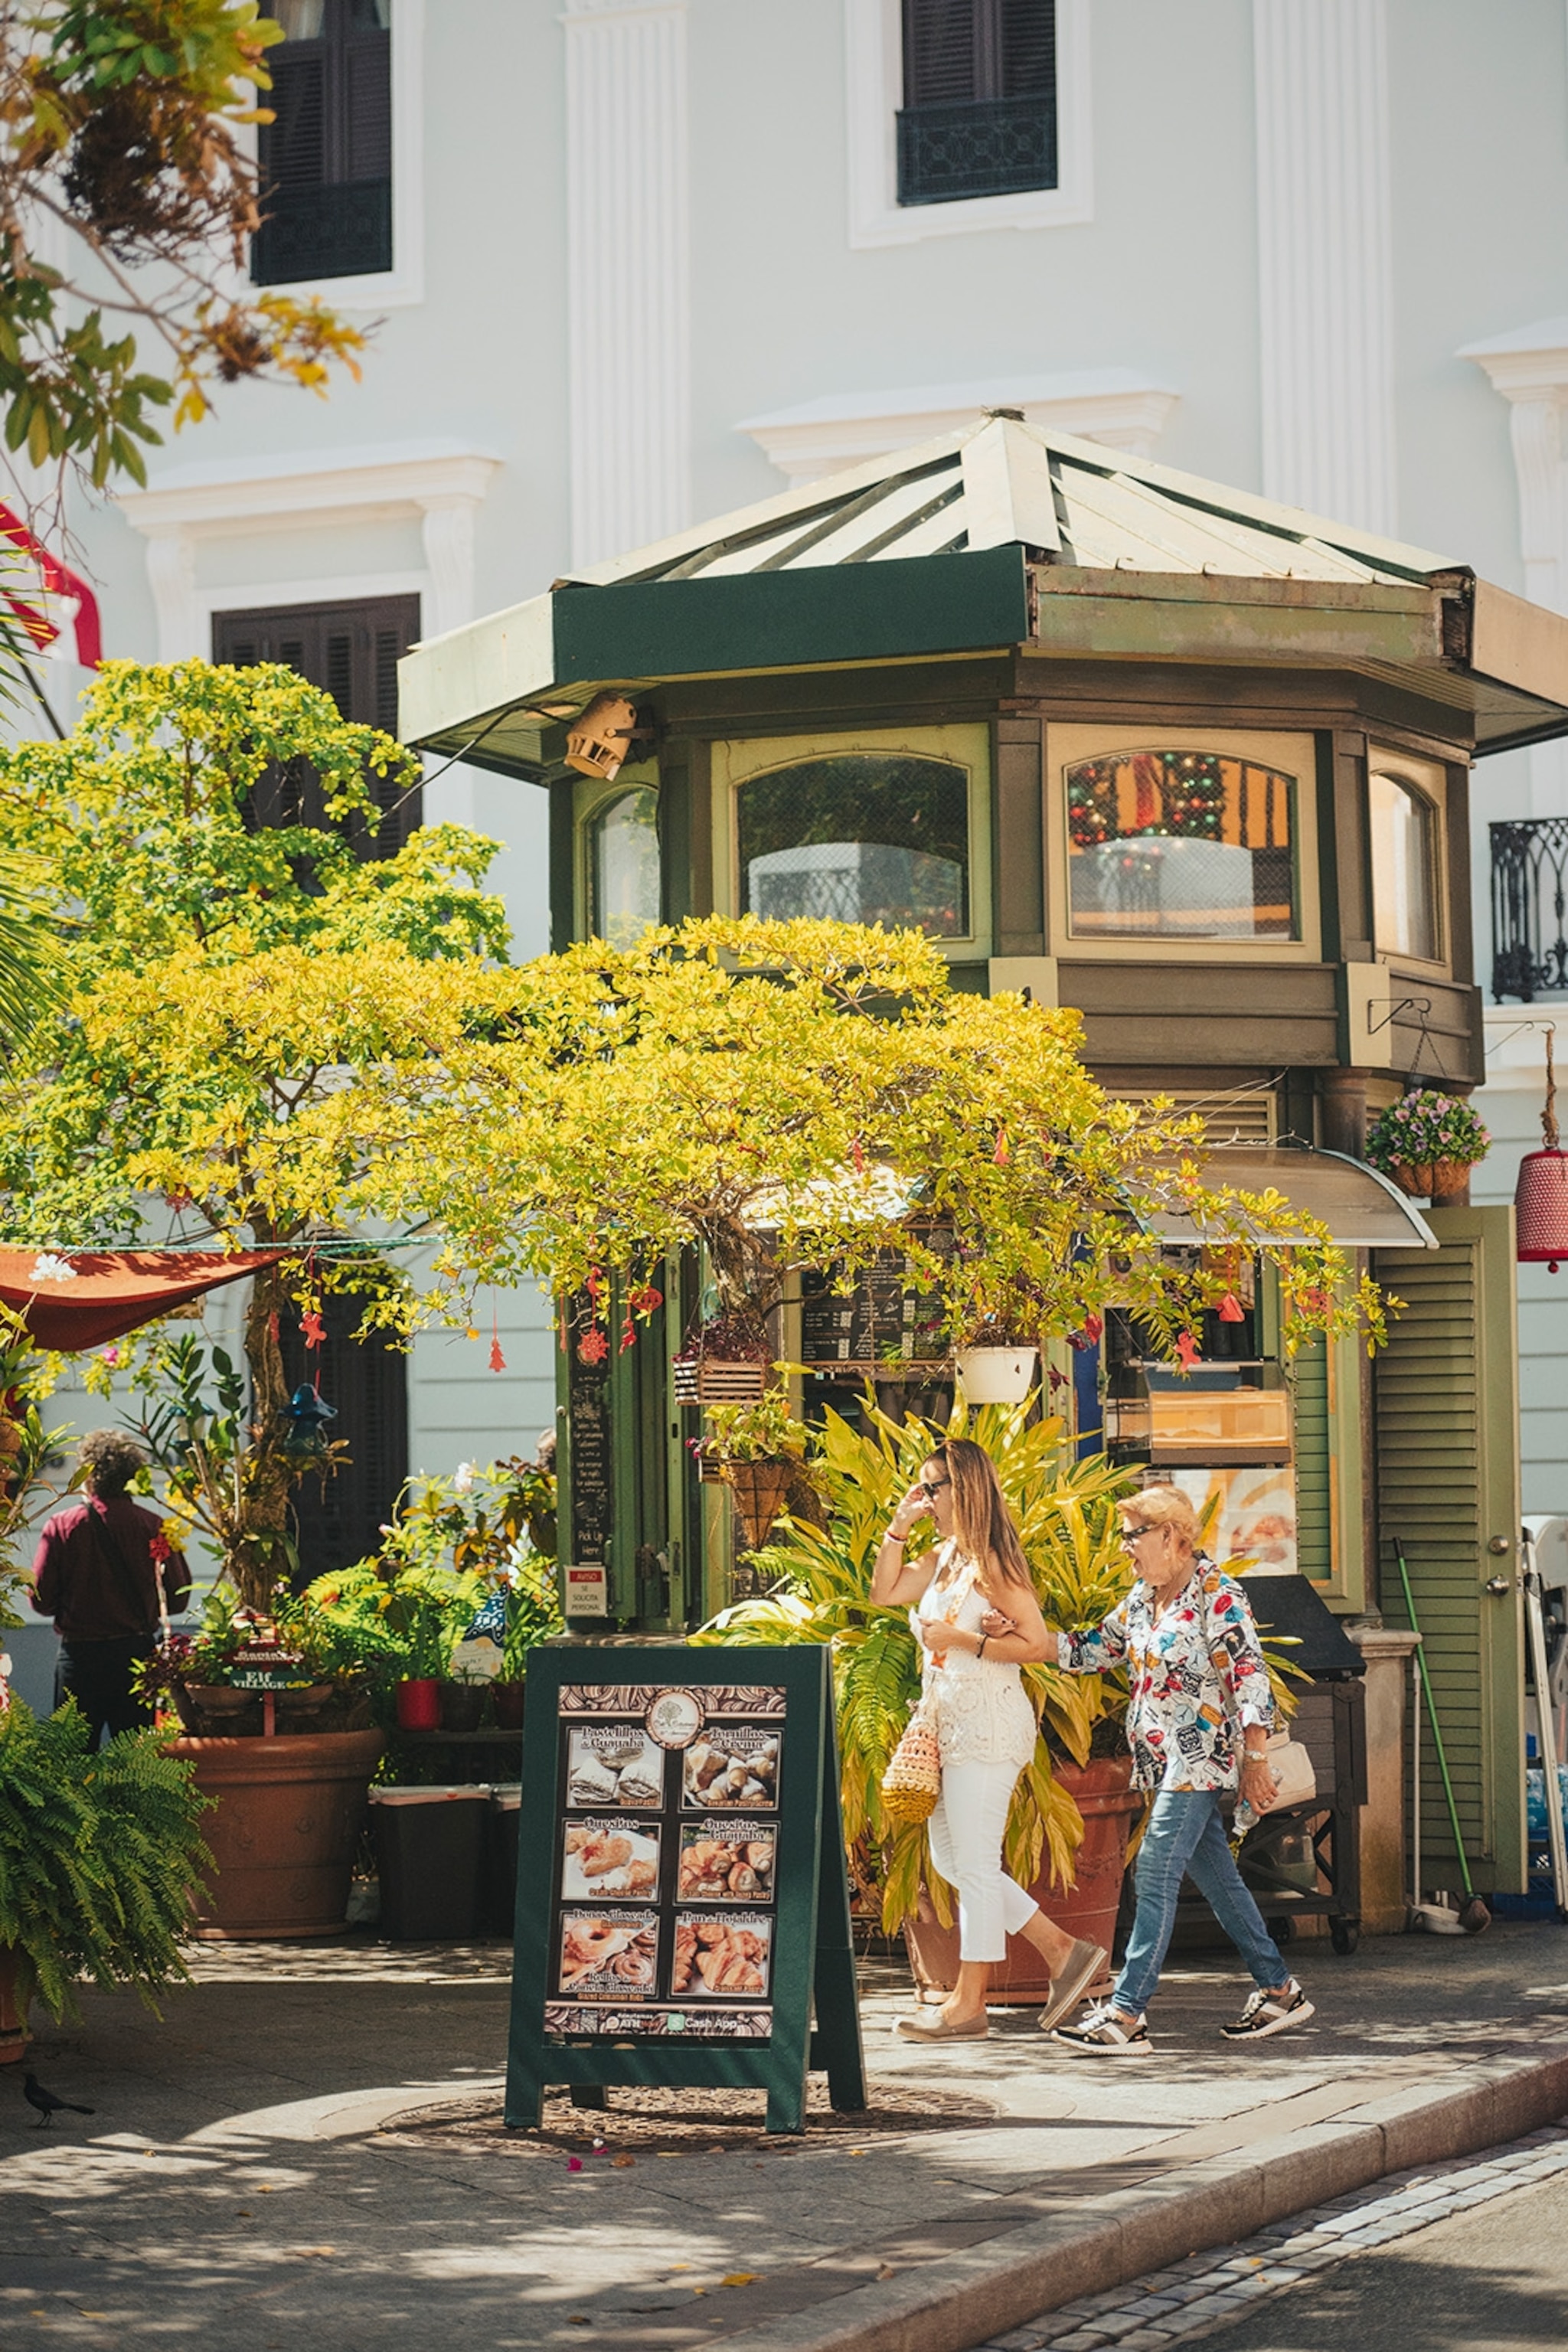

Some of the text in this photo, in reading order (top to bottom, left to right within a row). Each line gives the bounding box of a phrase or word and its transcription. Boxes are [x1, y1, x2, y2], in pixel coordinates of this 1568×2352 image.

[578, 1530, 603, 1544] Pick Up
[246, 1671, 273, 1683] Elf
[233, 1680, 286, 1690] VILLAGE
[582, 1725, 644, 1738] Pastelillos
[591, 1737, 645, 1750] Guayaba
[585, 1817, 639, 1828] Quesitos
[704, 1818, 758, 1830] Quesitos
[710, 1830, 765, 1843] Guayaba
[681, 1911, 705, 1922] Pan
[715, 1912, 766, 1926] Hojaldre
[685, 2017, 712, 2029] Cash
[714, 2019, 737, 2030] App
